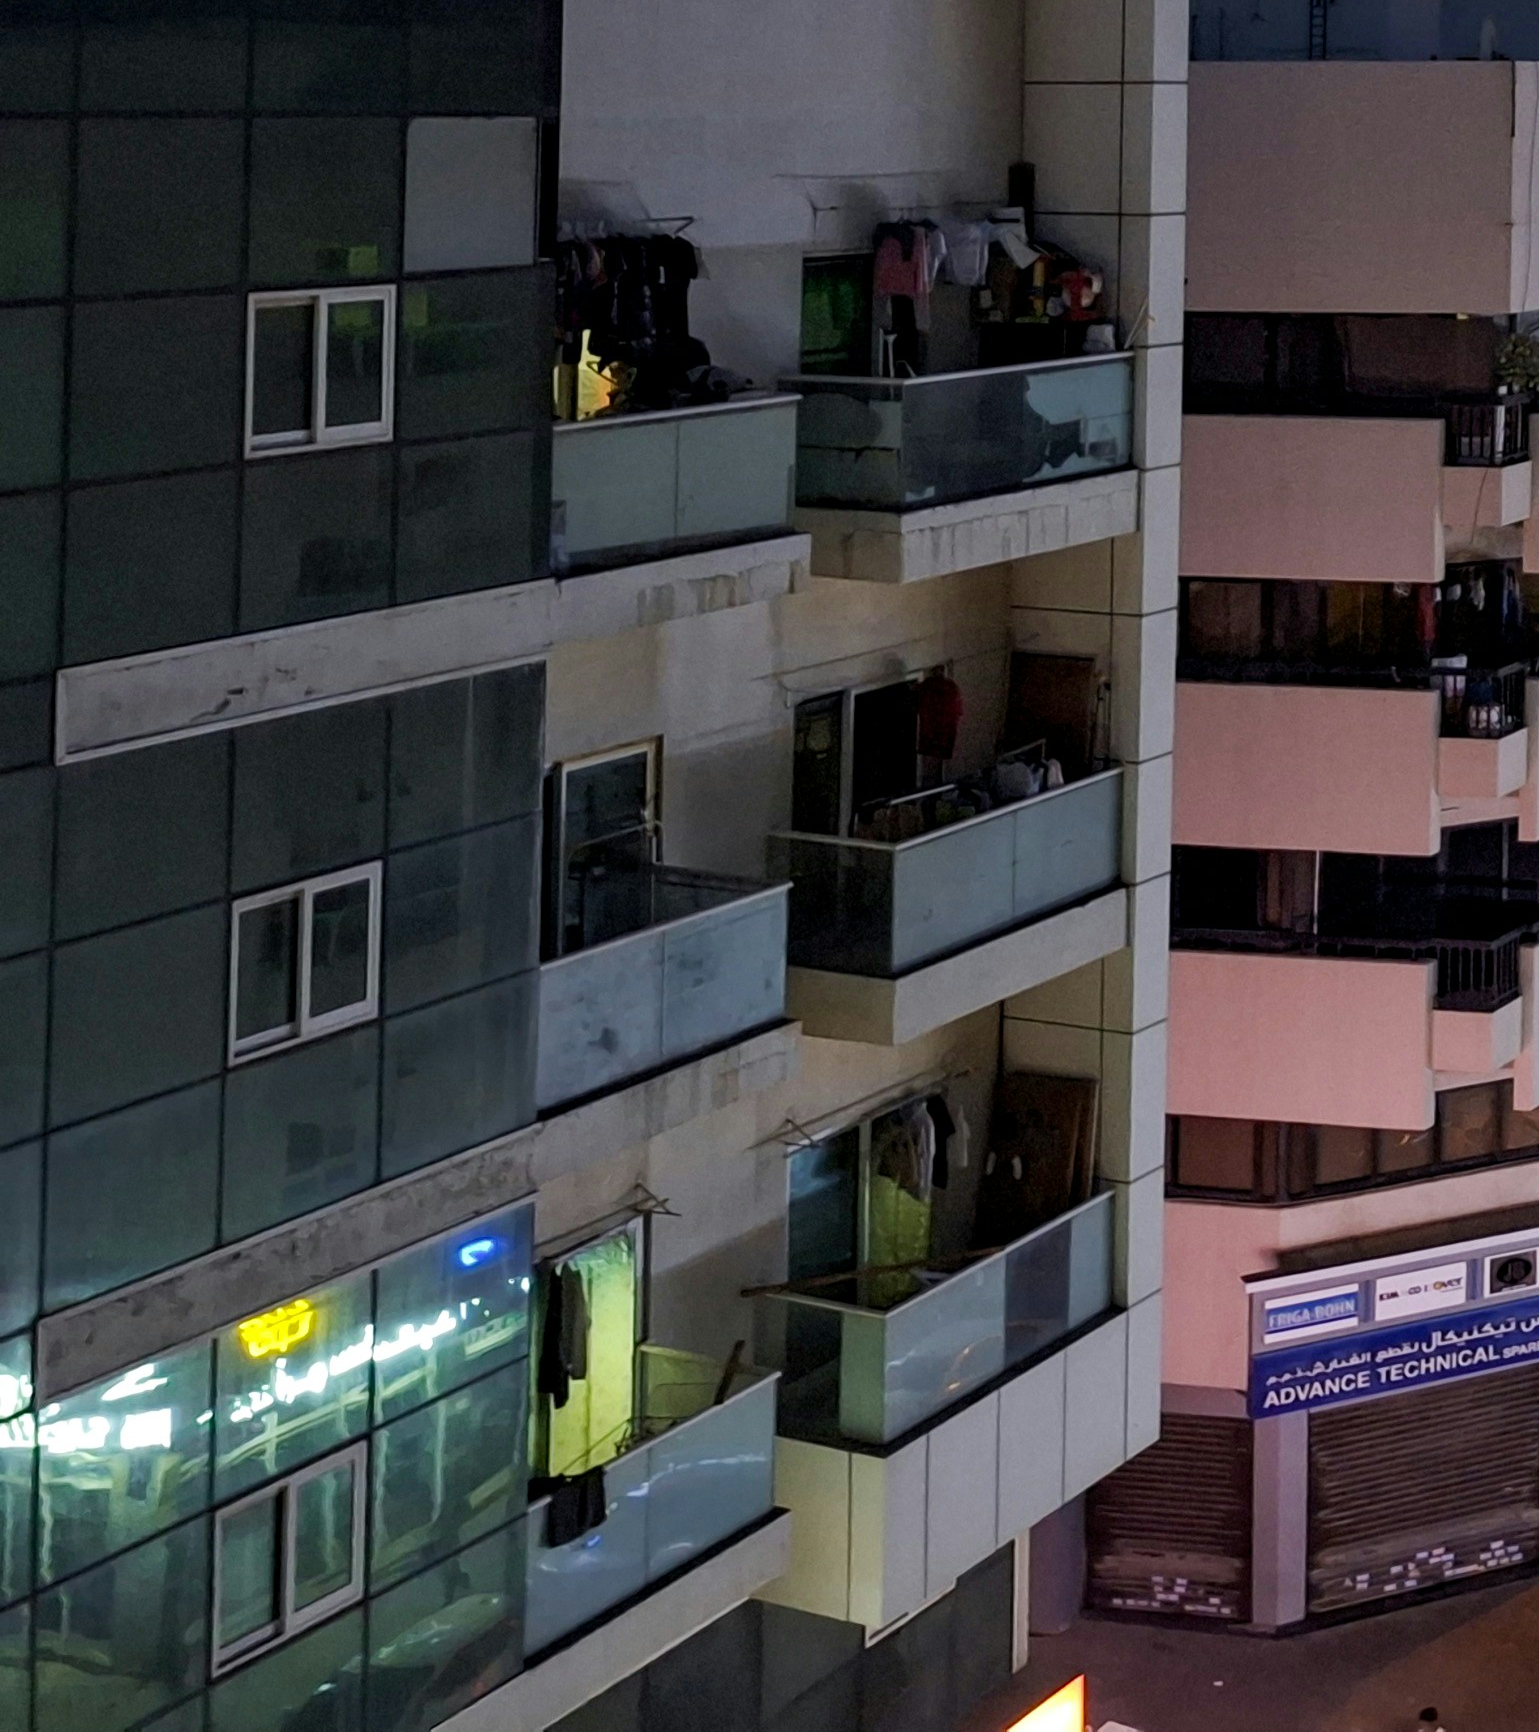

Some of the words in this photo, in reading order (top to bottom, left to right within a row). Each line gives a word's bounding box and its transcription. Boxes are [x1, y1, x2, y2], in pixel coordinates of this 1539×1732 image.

[1375, 1342, 1419, 1363] لقطع
[1421, 1317, 1516, 1353] تيكنيكال
[1263, 1371, 1371, 1409] ADVANCE
[1377, 1345, 1500, 1384] TECHNICAL
